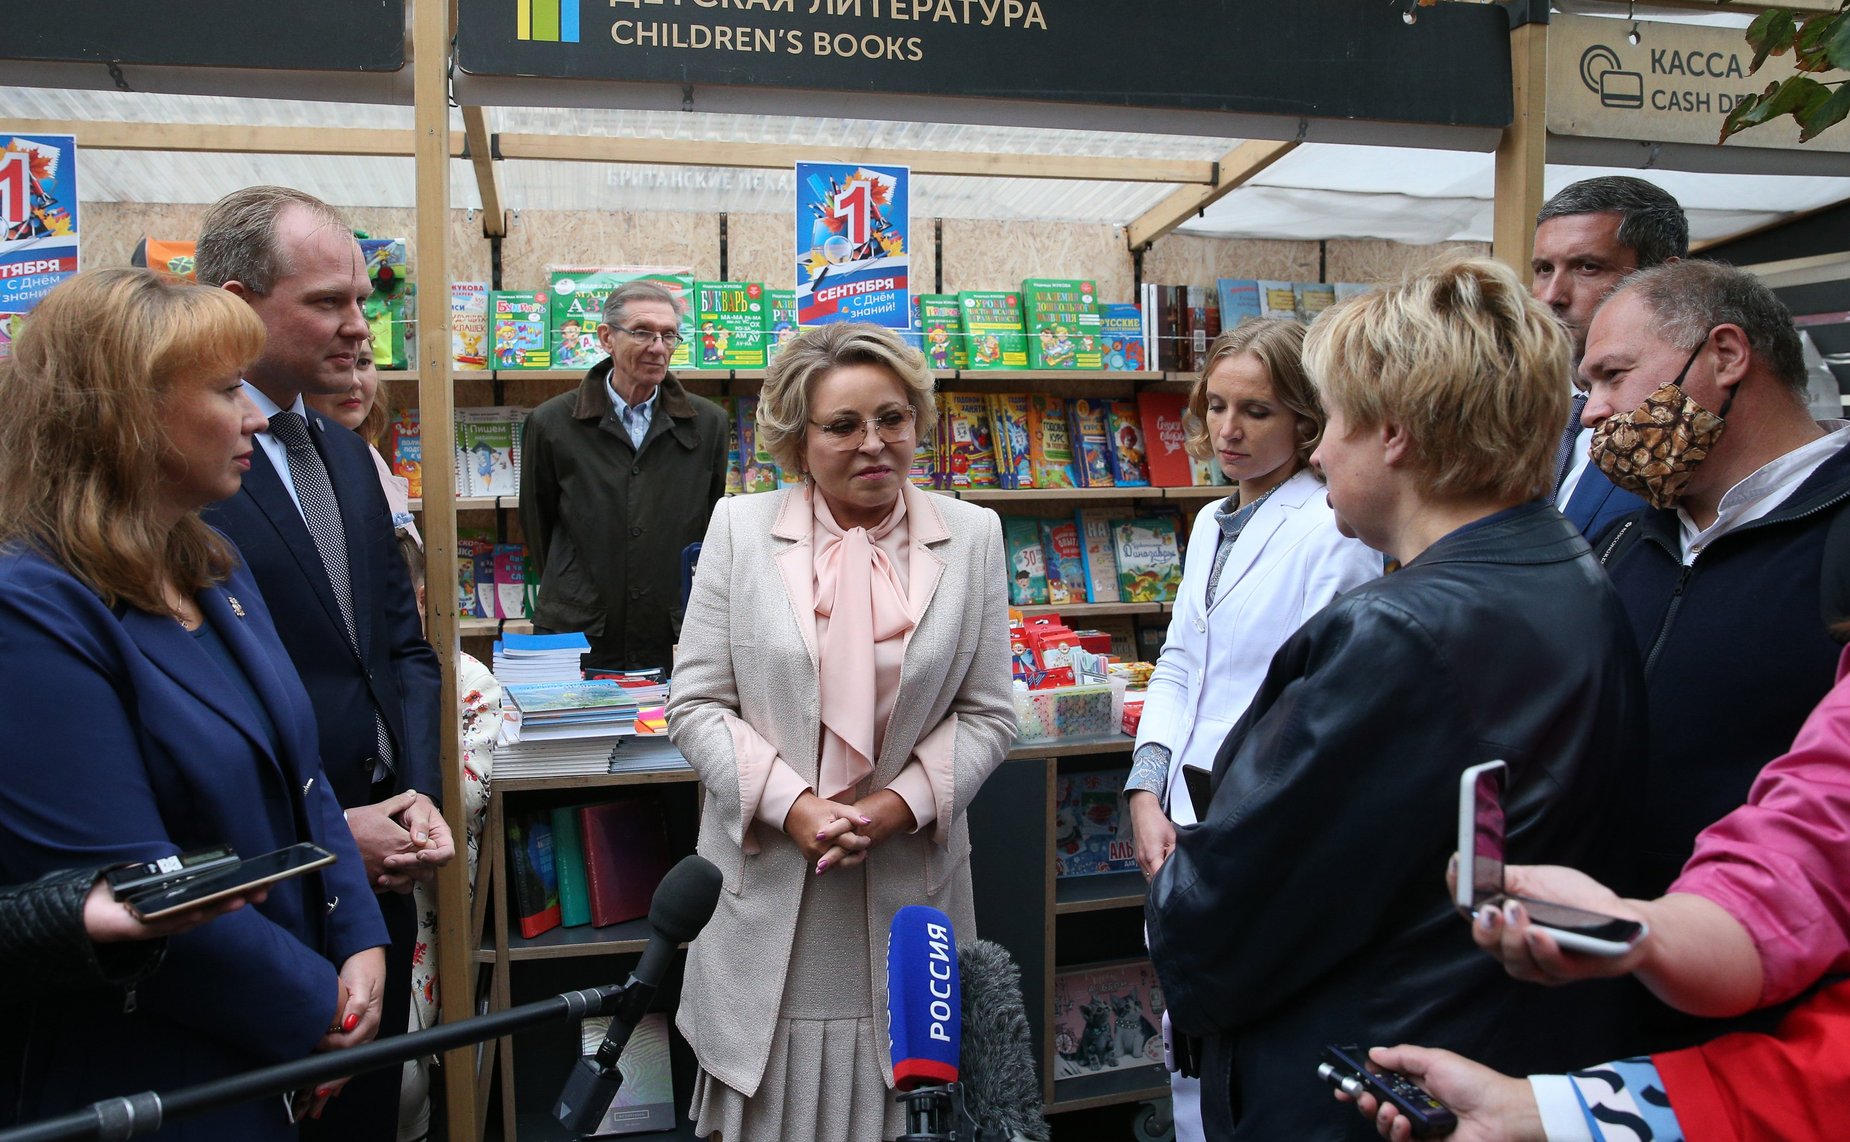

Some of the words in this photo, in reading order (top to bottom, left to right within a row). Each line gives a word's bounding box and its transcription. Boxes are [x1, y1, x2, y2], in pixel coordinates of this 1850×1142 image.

[611, 20, 803, 55] CHILDREN'S
[814, 31, 924, 62] BOOKS
[1651, 48, 1743, 79] КАССА
[1651, 89, 1711, 113] CASH
[837, 183, 868, 248] 1
[0, 259, 61, 278] ТЯБРЯ
[701, 290, 748, 312] БУКВАРЬ
[816, 278, 894, 303] СЕНТЯБРЯ
[853, 297, 862, 307] С
[864, 291, 895, 306] Днём
[772, 309, 797, 322] РЕЧ
[850, 302, 896, 319] знаний!
[1110, 840, 1135, 860] АЛЬ
[927, 922, 951, 1043] РОССИЯ
